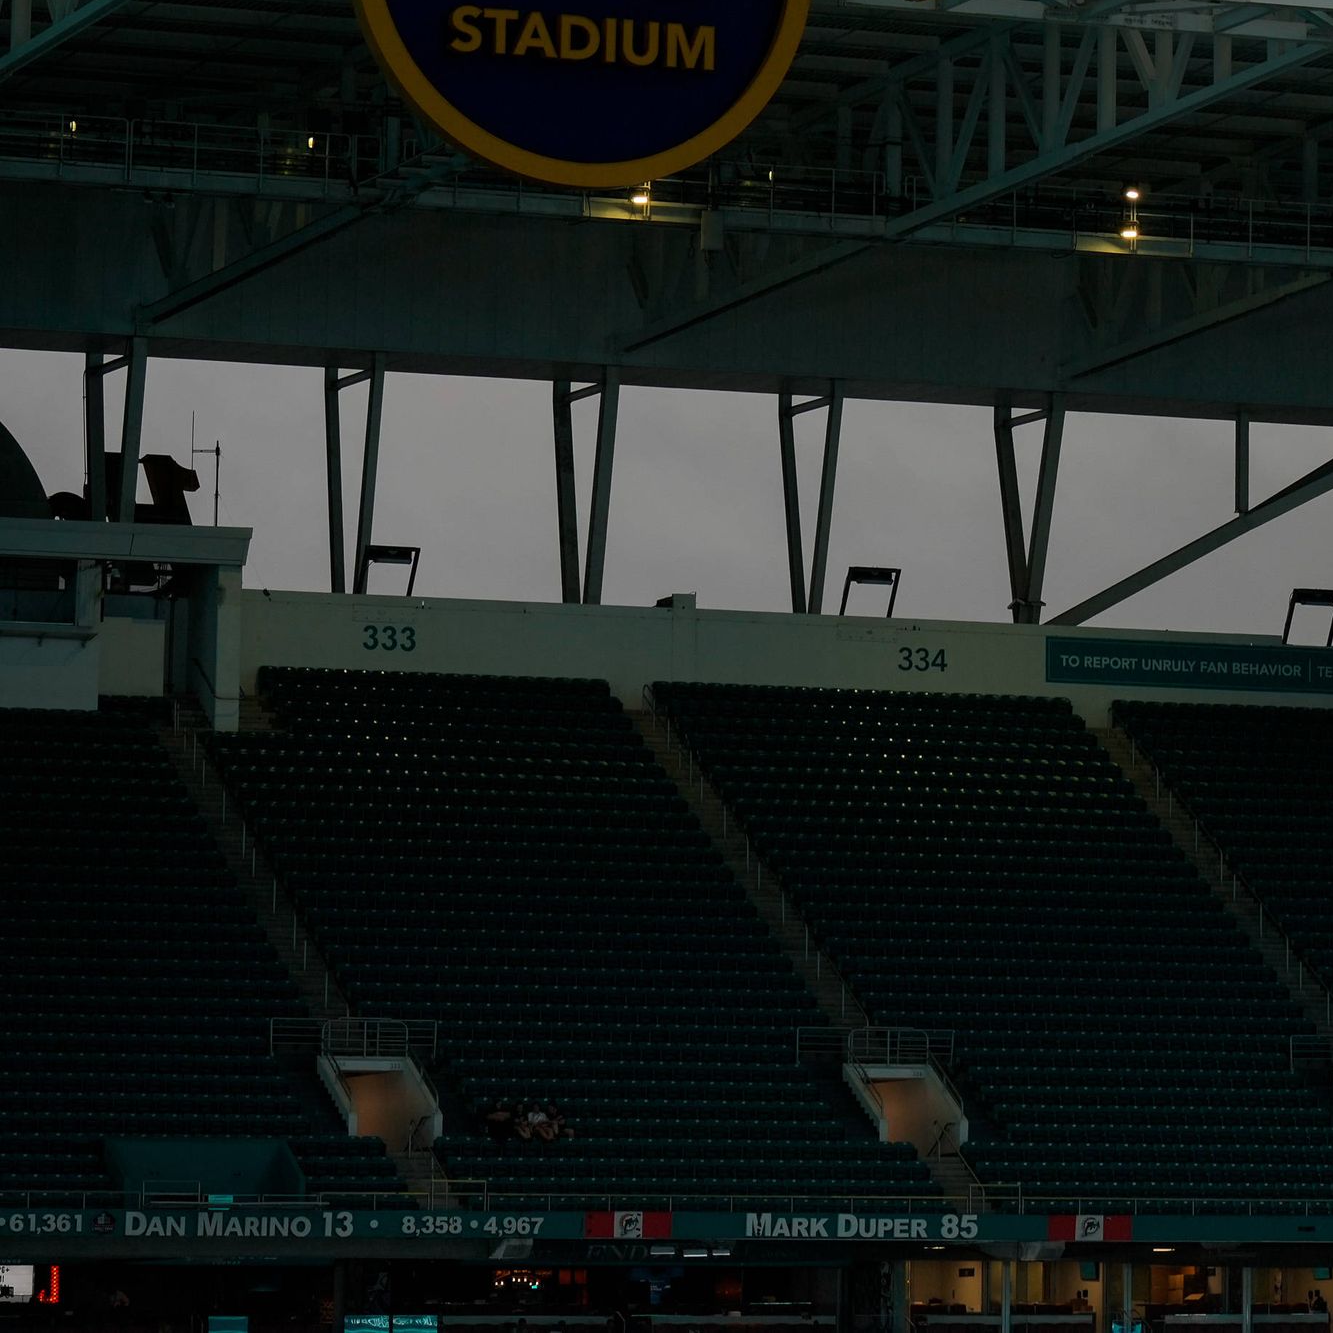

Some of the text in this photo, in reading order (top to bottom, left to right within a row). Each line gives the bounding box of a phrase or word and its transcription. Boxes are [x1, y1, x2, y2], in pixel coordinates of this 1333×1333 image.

[447, 3, 717, 72] STADIUM
[363, 625, 416, 652] 333
[898, 647, 948, 672] 334
[1060, 654, 1080, 667] TO
[1084, 656, 1138, 670] REPORT
[1142, 659, 1196, 673] UNRULY
[1200, 661, 1228, 674] FAN
[1232, 663, 1302, 678] BEHAVIOR
[9, 1212, 83, 1235] 61,361
[124, 1211, 354, 1238] DAN MARINO 13
[401, 1214, 544, 1237] 8,358 4,967
[745, 1212, 979, 1239] MARK DUPER 85
